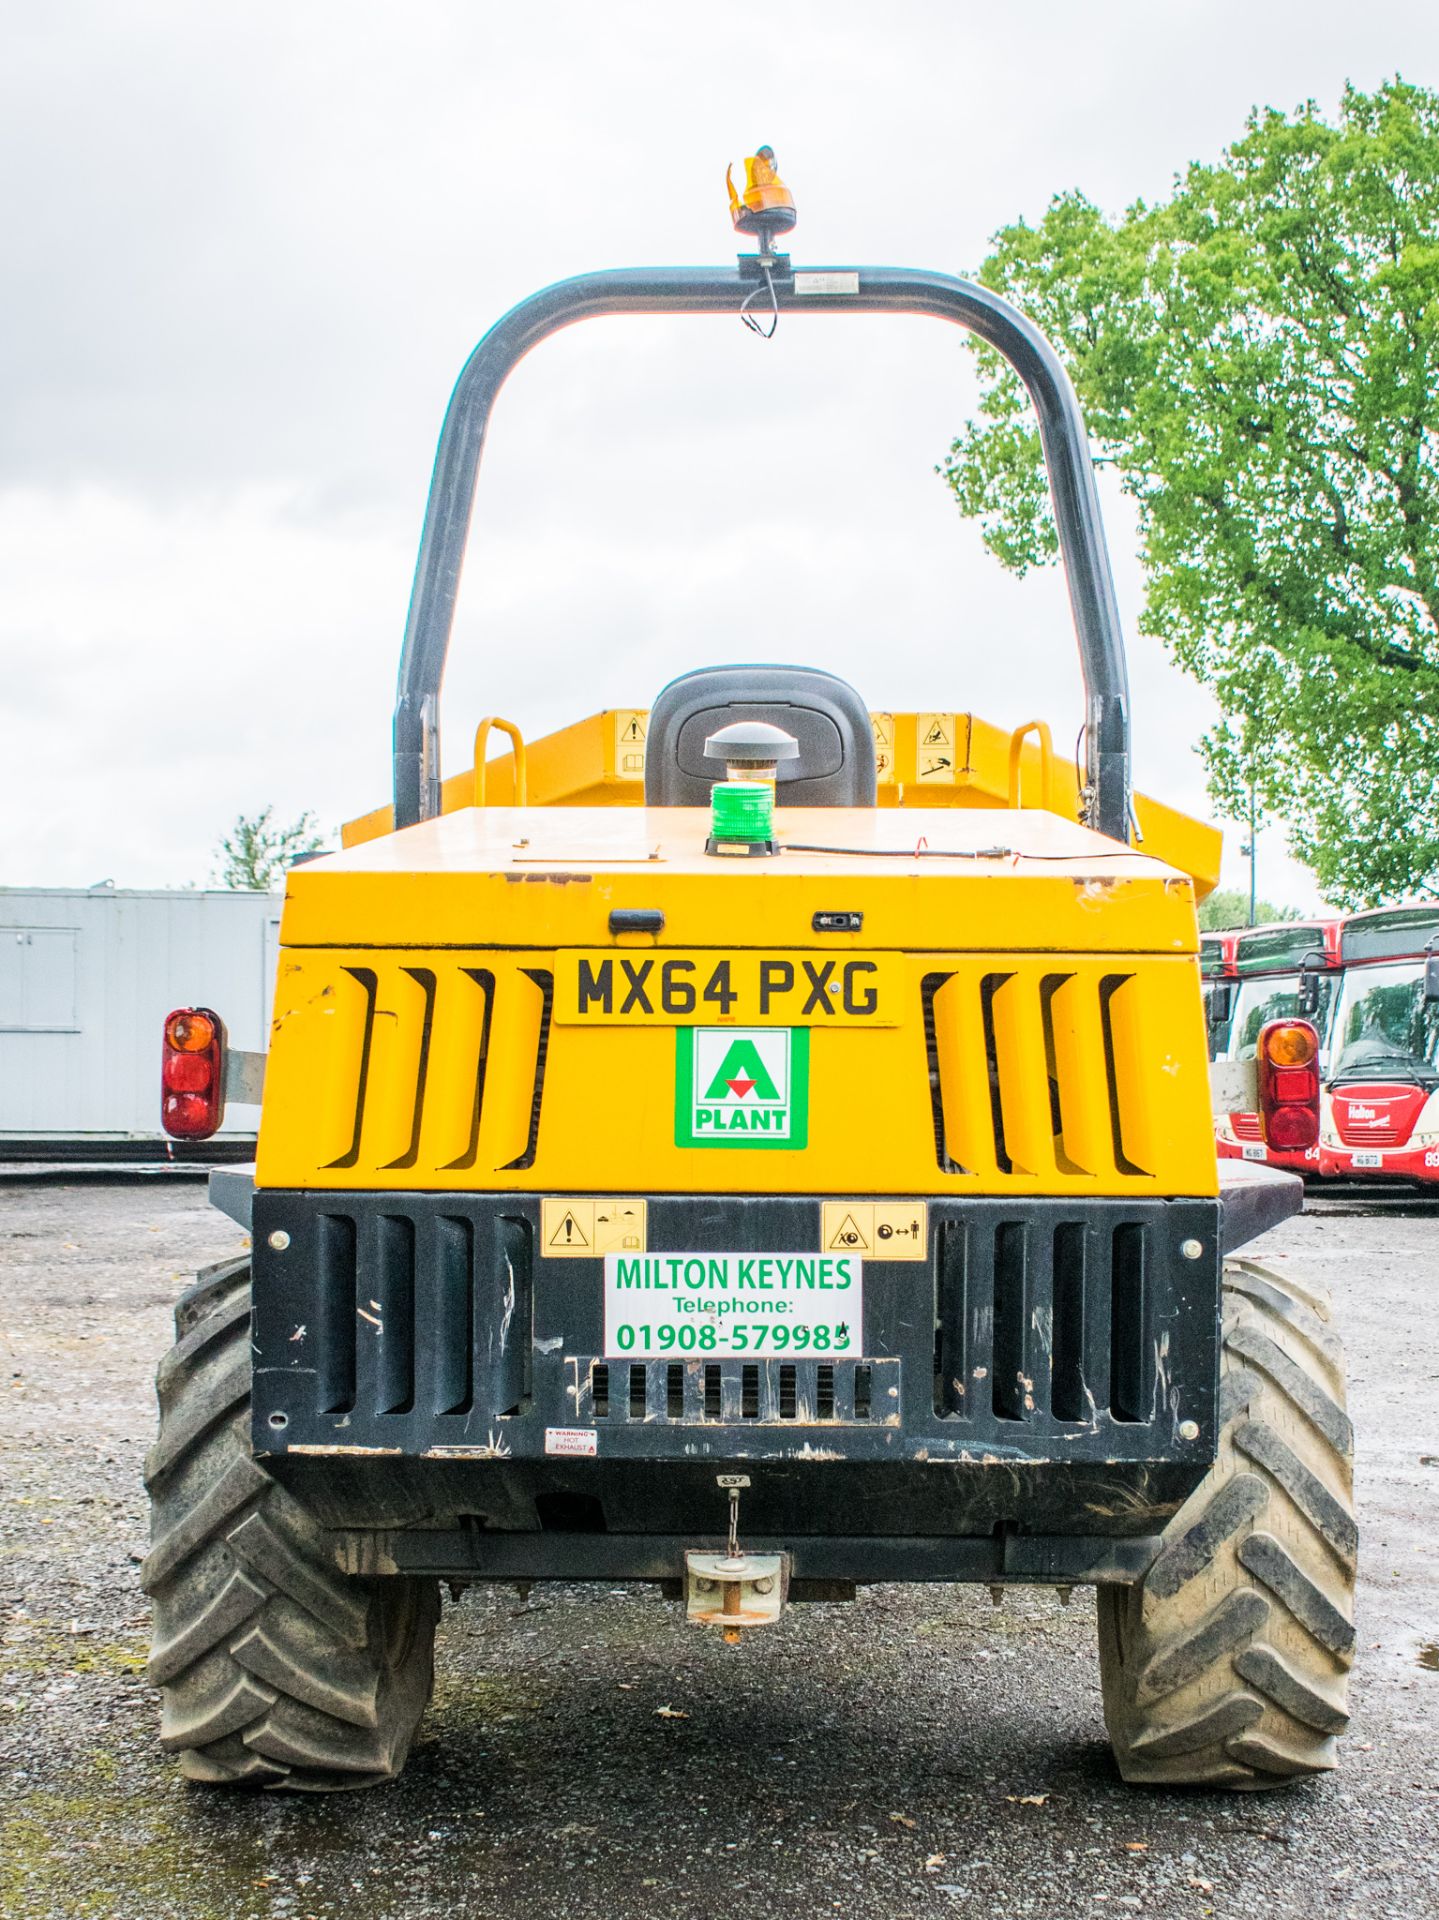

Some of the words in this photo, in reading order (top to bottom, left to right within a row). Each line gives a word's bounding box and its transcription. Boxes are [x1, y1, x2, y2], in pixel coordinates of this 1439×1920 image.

[578, 960, 738, 1015] MX64
[760, 961, 878, 1016] PXG
[704, 1039, 781, 1100] A
[695, 1108, 787, 1131] PLANT
[616, 1258, 728, 1290] MILTON
[738, 1258, 851, 1290] KEYNES
[672, 1296, 794, 1319] Telephone:
[616, 1324, 851, 1351] 01908-579985
[555, 1443, 587, 1451] EXHAUST
